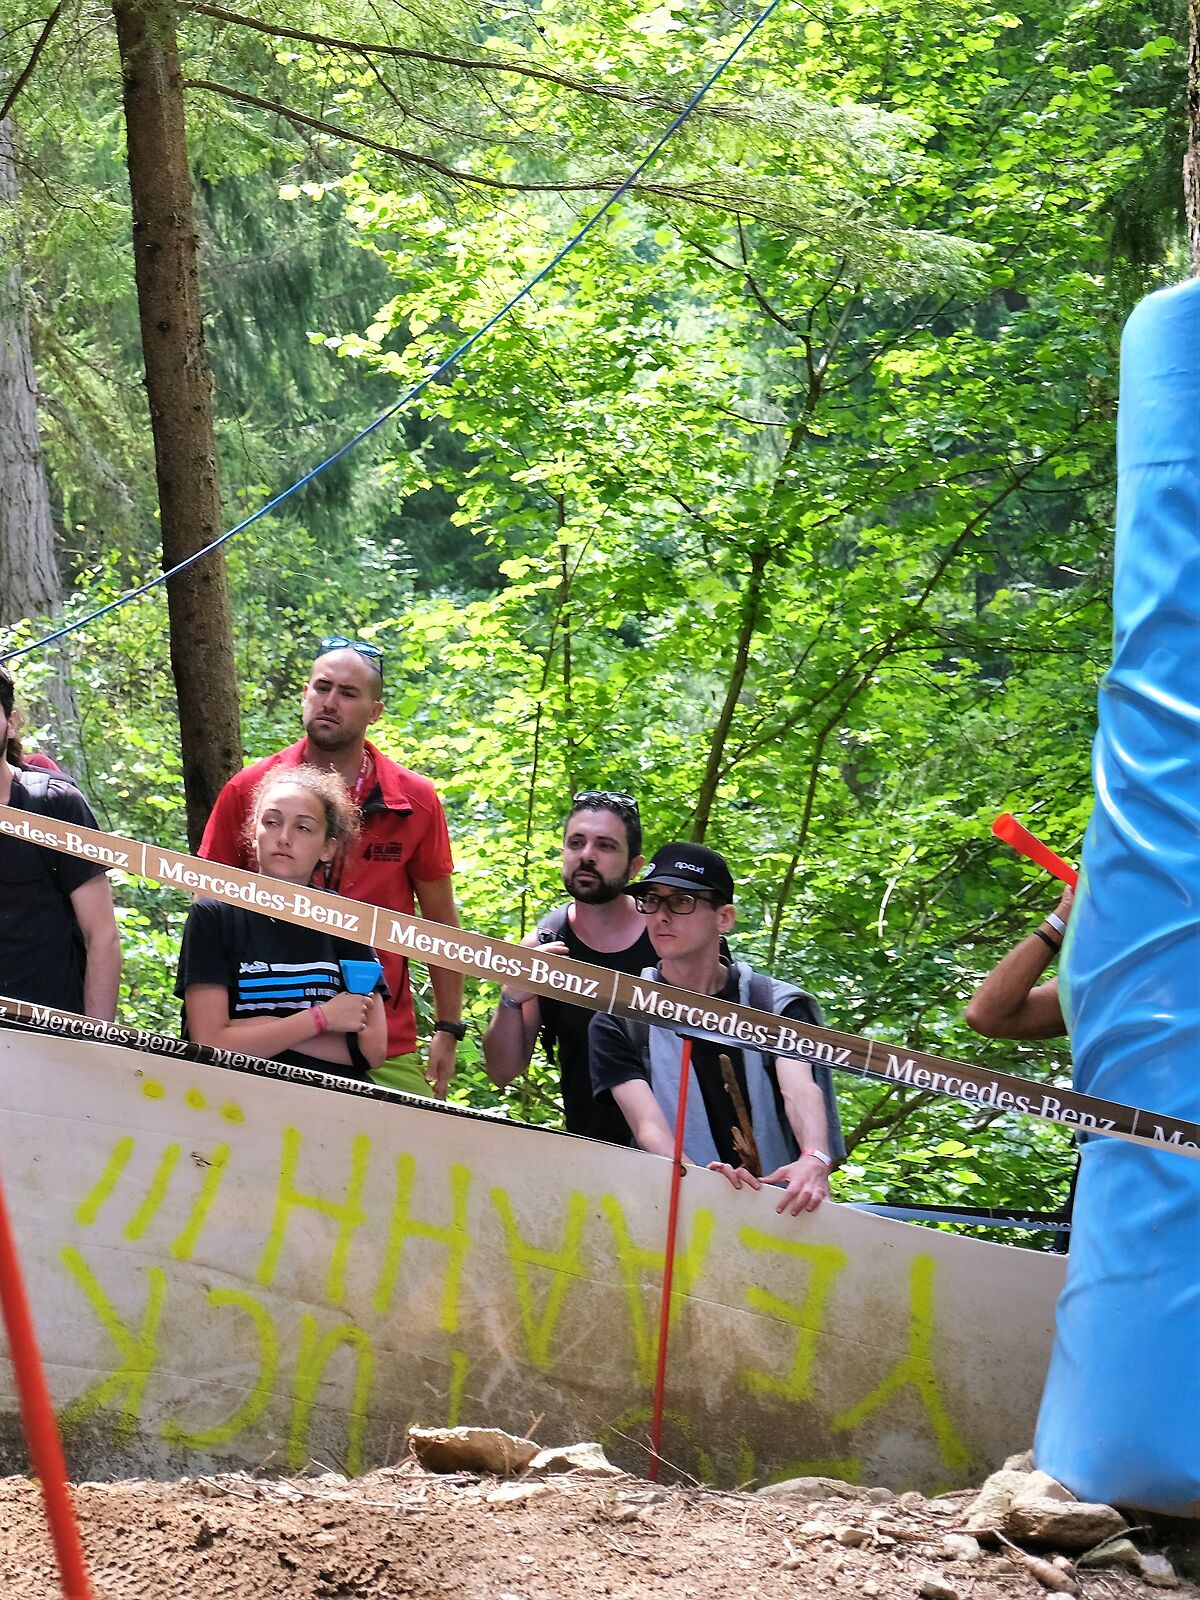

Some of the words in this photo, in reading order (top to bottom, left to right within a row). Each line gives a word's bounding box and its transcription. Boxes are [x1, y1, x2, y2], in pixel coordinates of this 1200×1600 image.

[158, 857, 359, 933] Mercedes-Benz
[387, 919, 600, 999] Mercedes-Benz
[30, 1006, 189, 1056] Mercedes-Benz
[627, 985, 853, 1067] Mercedes-Benz
[884, 1053, 1117, 1133] Mercedes-Benz
